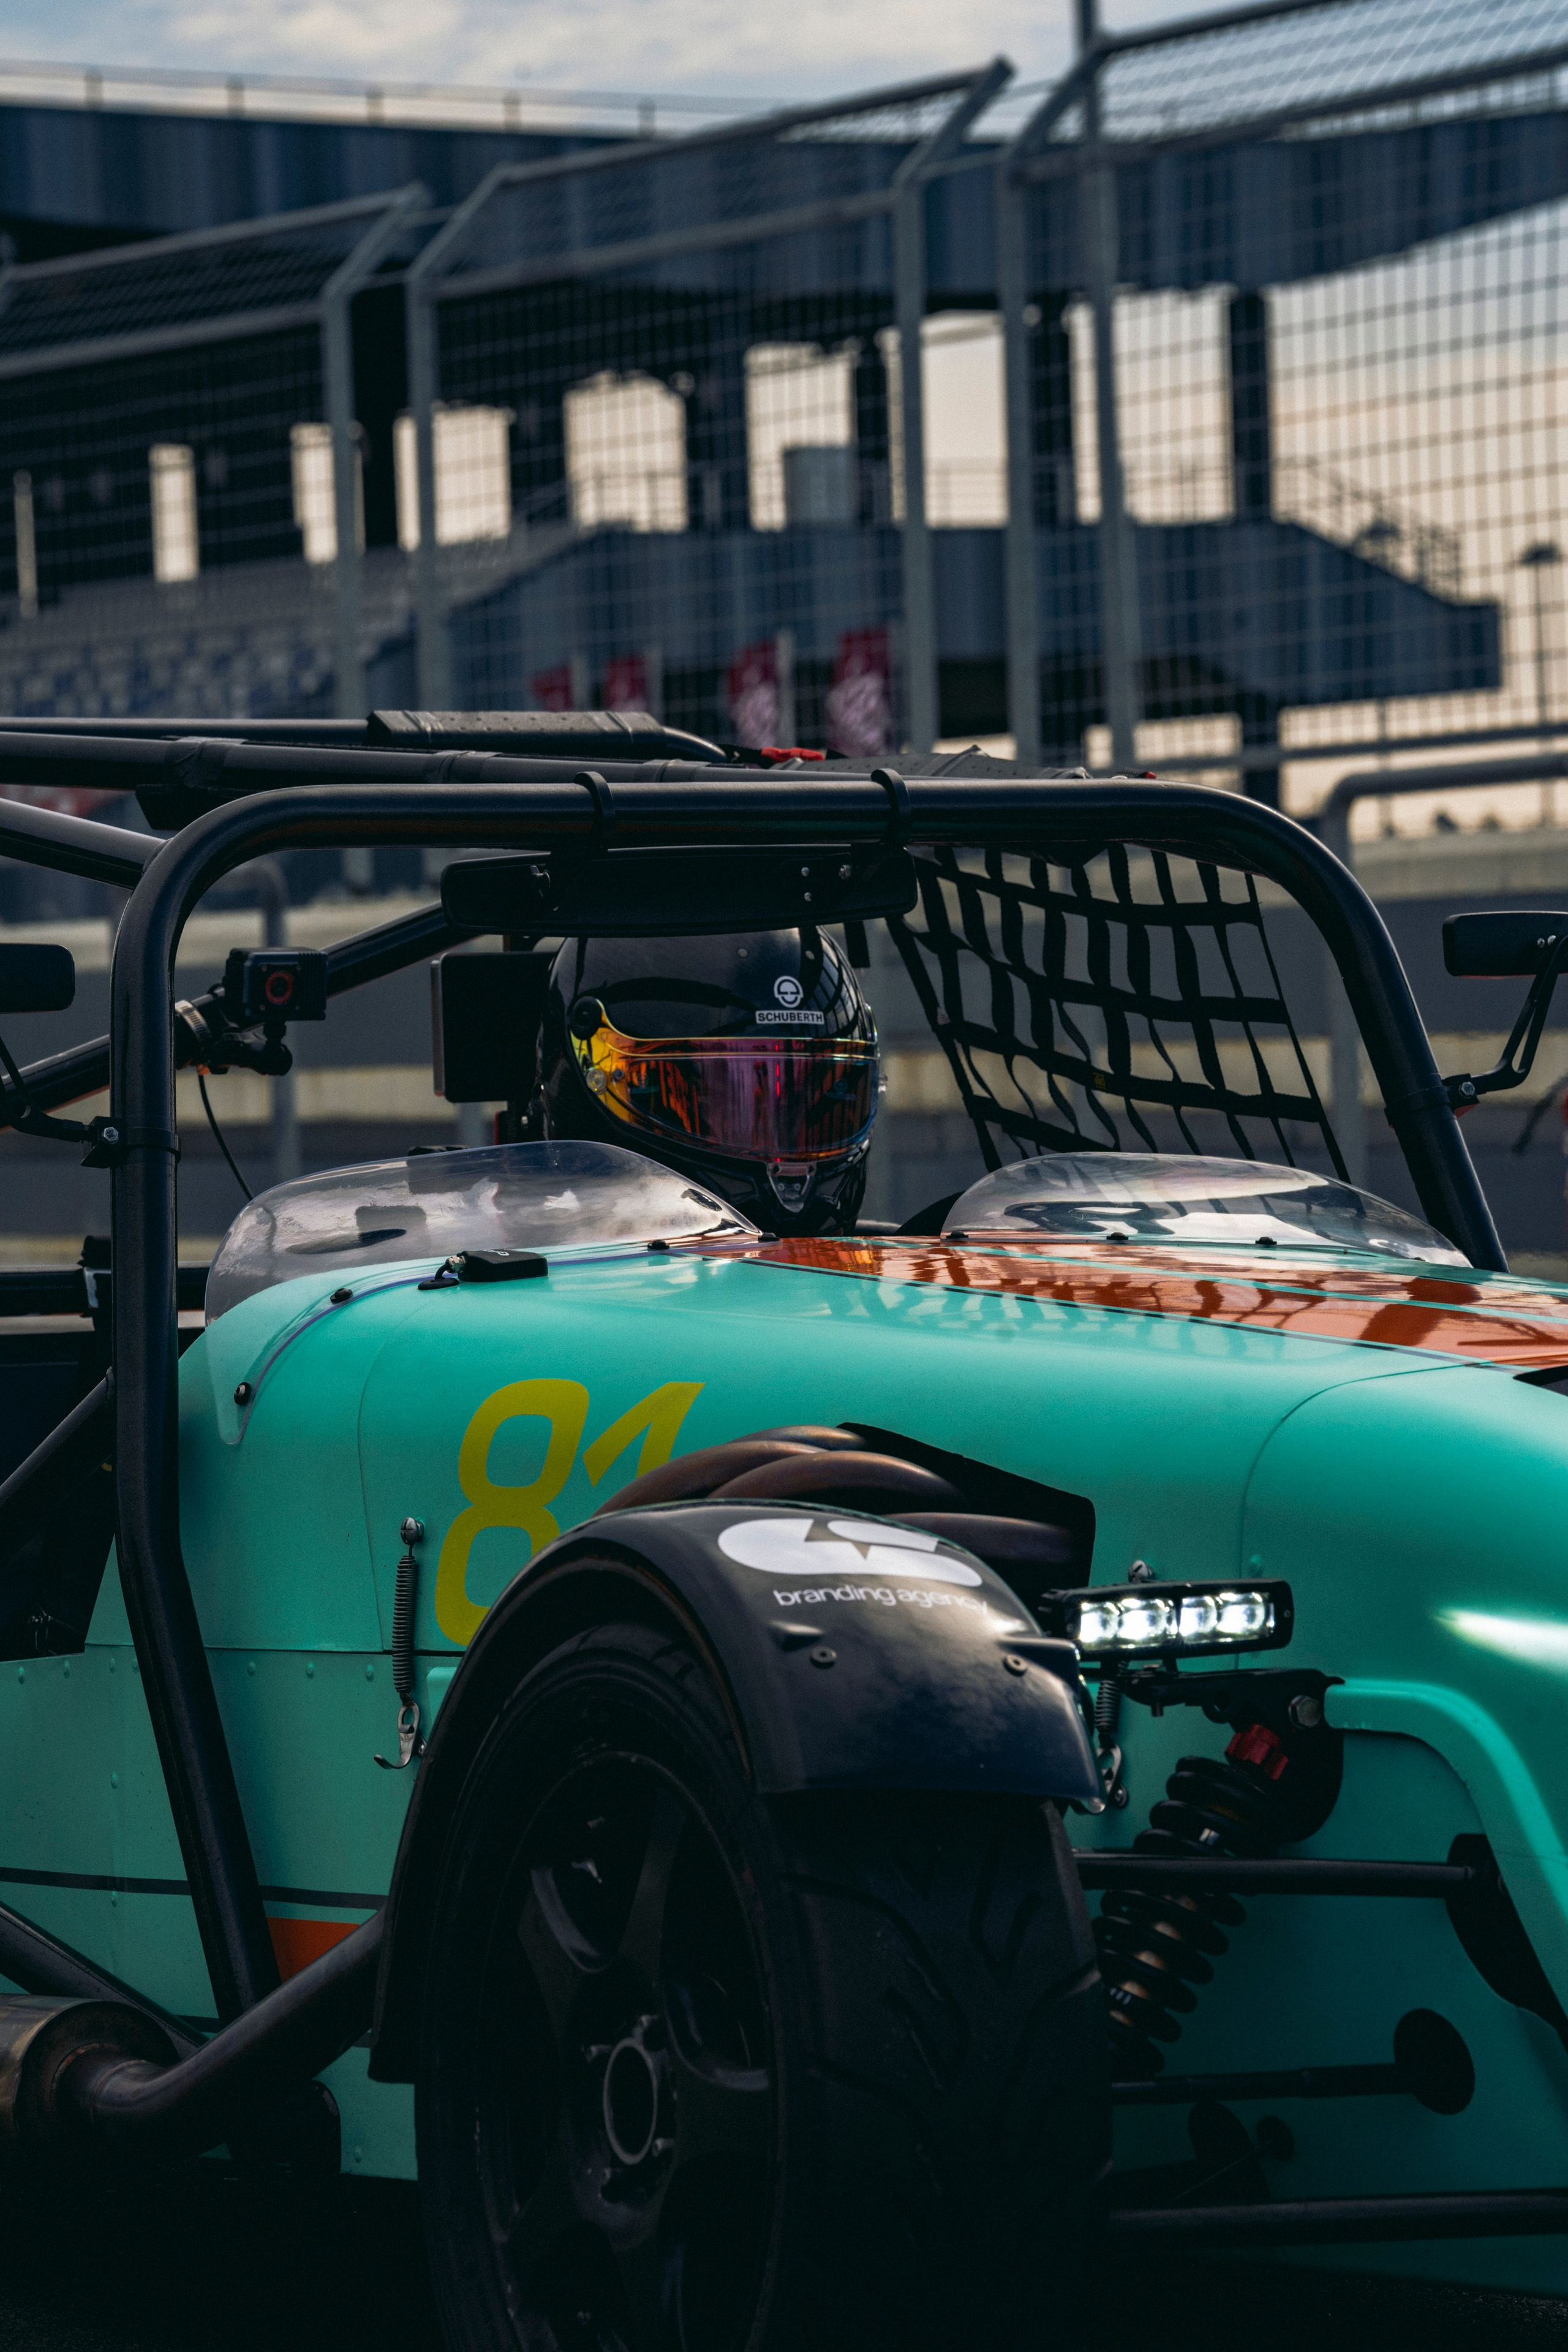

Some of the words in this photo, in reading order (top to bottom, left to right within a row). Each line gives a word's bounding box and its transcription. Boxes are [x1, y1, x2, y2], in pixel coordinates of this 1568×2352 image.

[758, 1012, 823, 1023] SCHUBERTH
[435, 1379, 706, 1646] 81
[774, 1585, 896, 1606] branding
